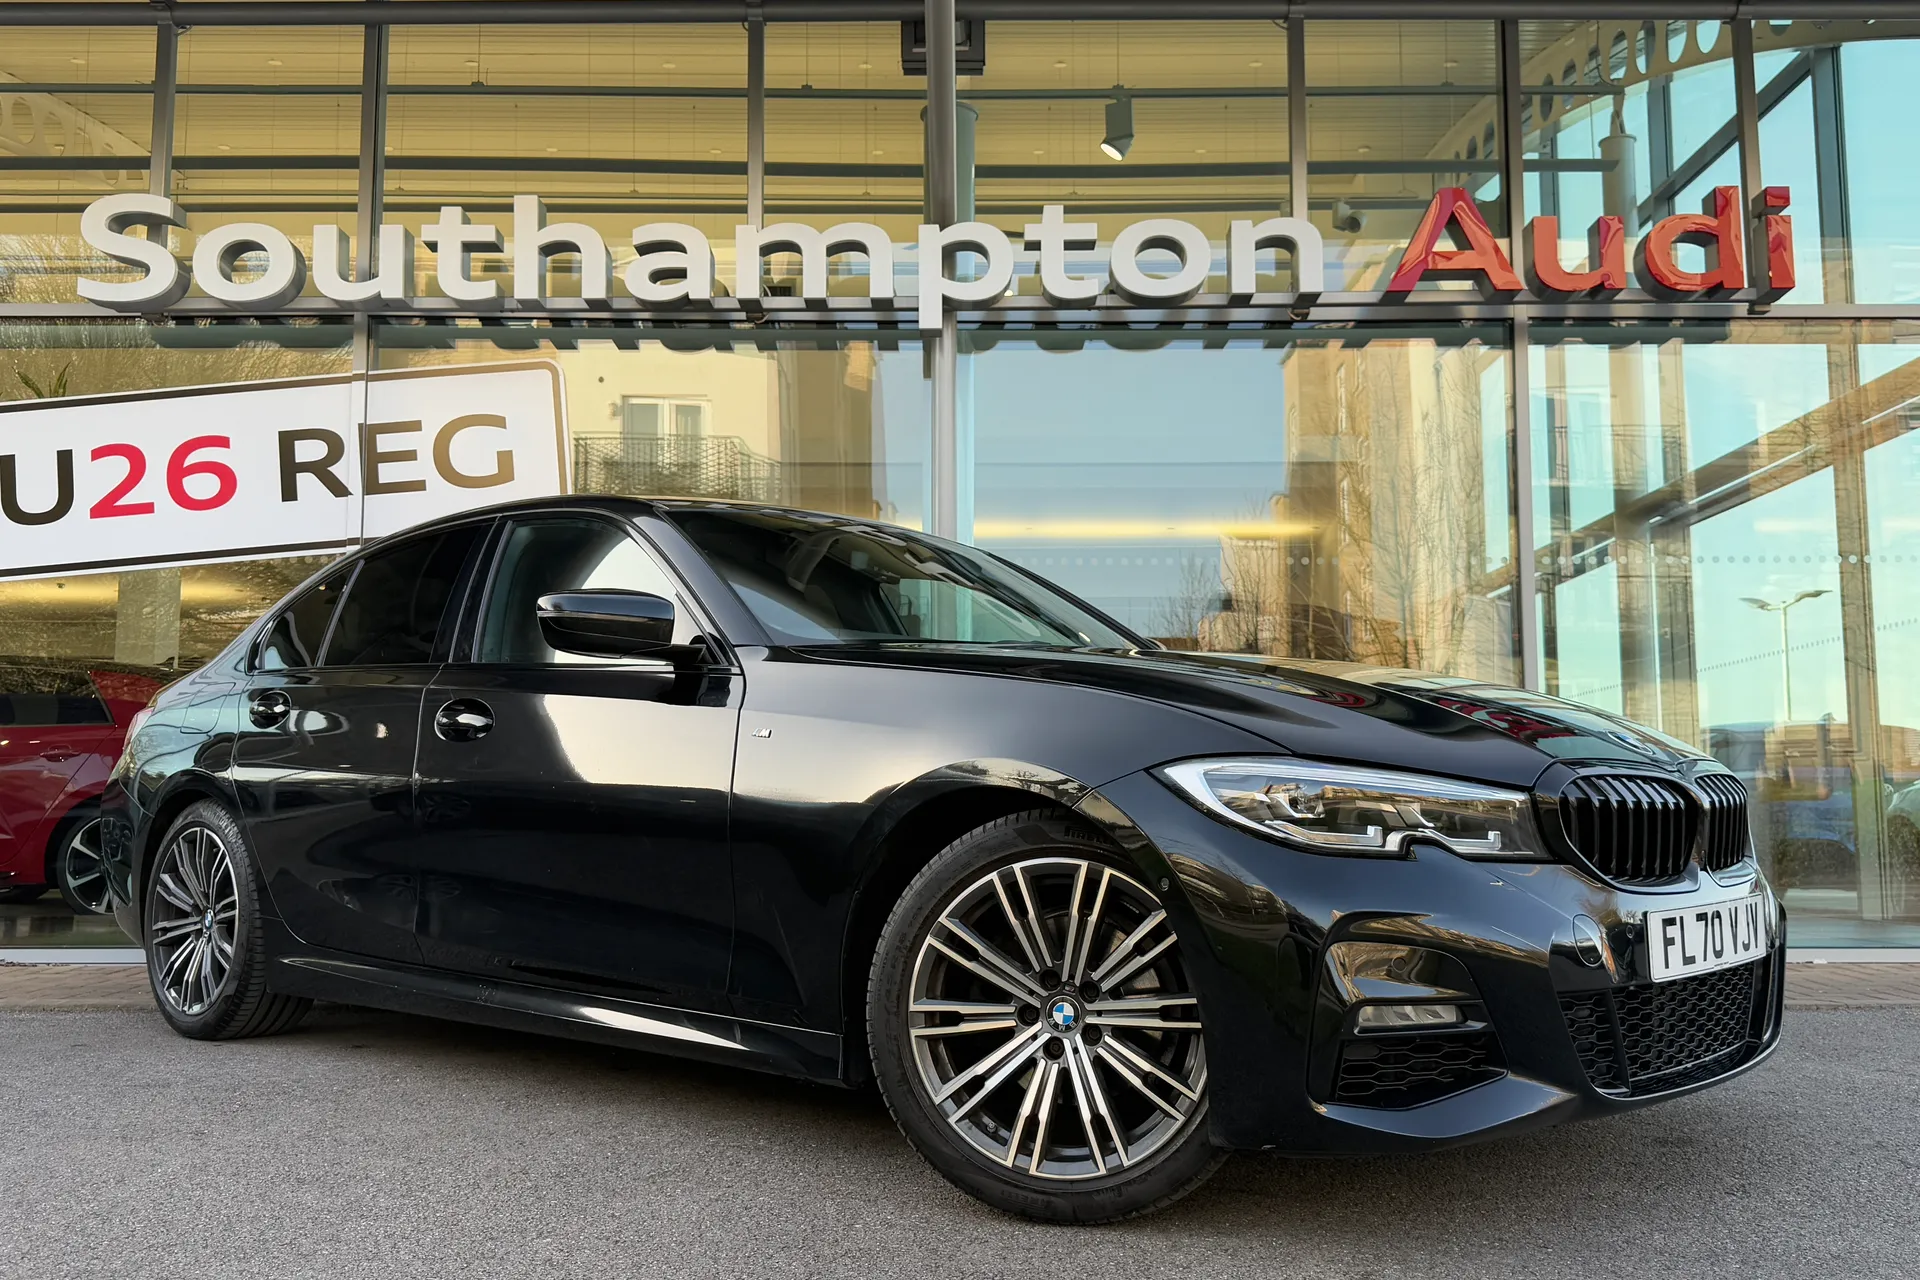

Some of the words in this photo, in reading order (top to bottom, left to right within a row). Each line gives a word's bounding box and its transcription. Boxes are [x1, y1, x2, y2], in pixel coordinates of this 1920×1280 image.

[77, 193, 1324, 334] Southampton
[1385, 186, 1796, 297] Audi
[0, 435, 238, 525] U26
[277, 414, 516, 503] REG
[1661, 909, 1725, 970] FL70
[1728, 901, 1759, 956] VJV
